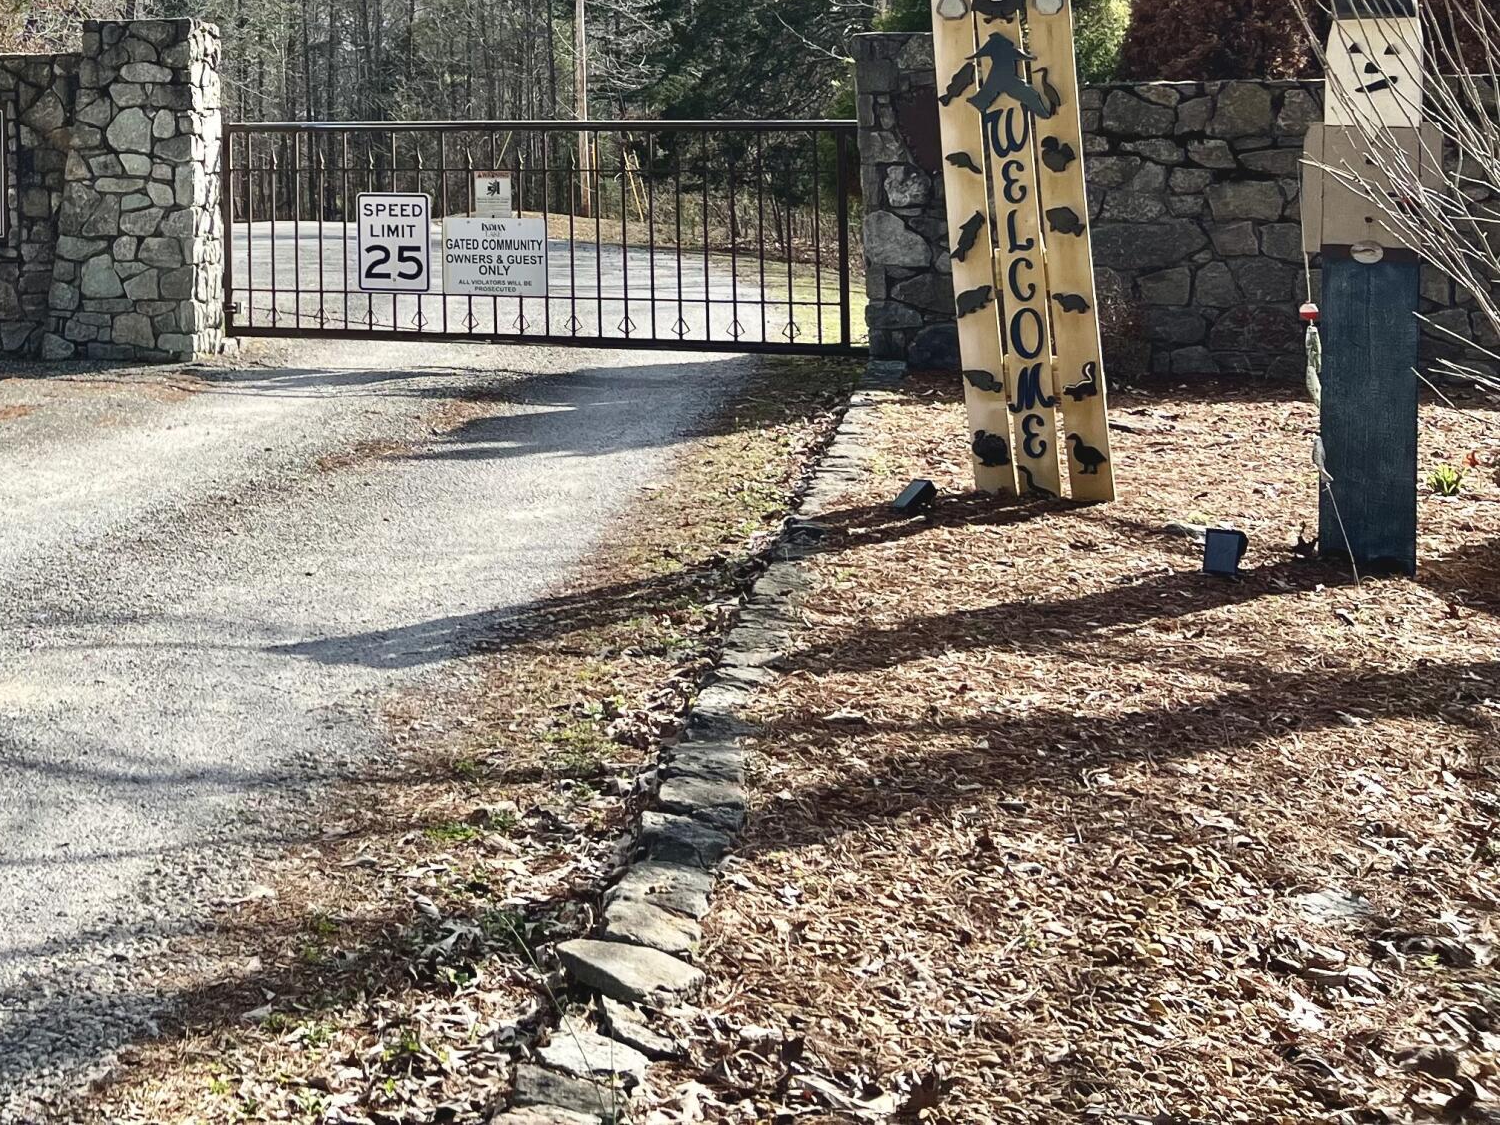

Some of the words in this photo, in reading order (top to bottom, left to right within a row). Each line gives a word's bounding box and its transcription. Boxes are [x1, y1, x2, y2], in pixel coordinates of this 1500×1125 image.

[363, 203, 423, 217] SPEED
[370, 224, 416, 238] LIMIT
[445, 238, 479, 250] GATED
[481, 239, 543, 251] COMMUNITY
[364, 244, 424, 281] 25
[445, 254, 493, 264] OWNERS
[496, 254, 504, 264] &
[506, 255, 544, 265] GUEST
[478, 265, 511, 276] ONLY
[983, 103, 1056, 460] WELCOME
